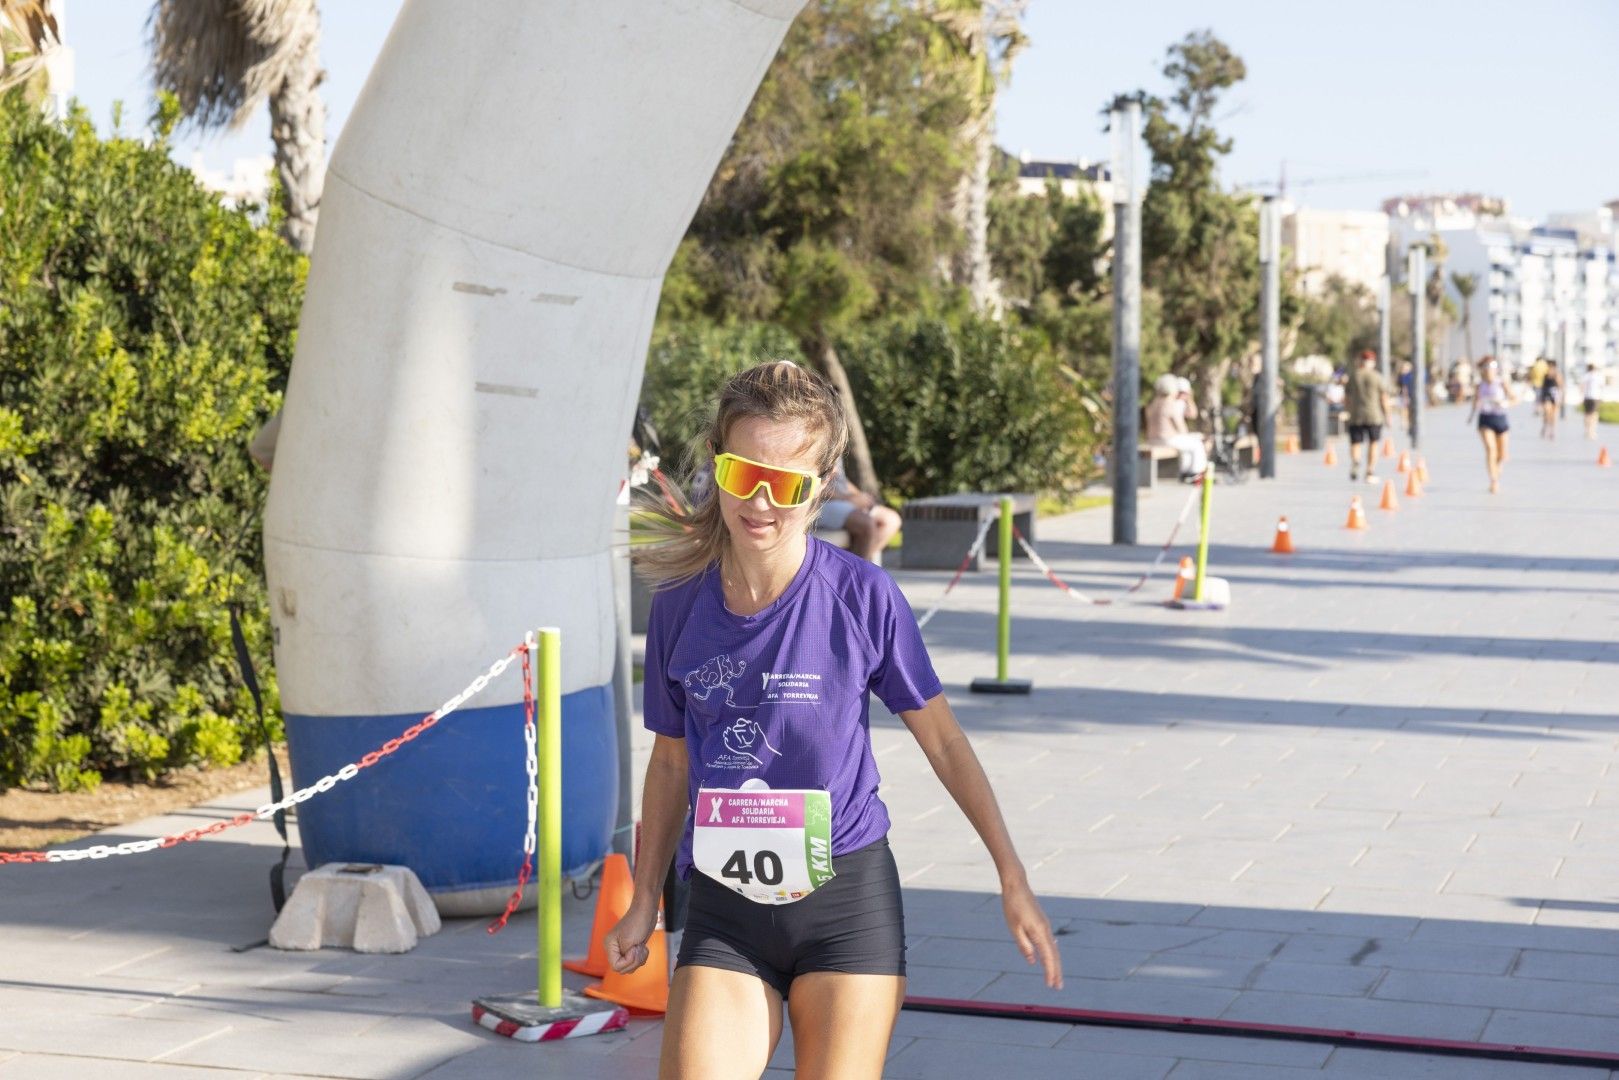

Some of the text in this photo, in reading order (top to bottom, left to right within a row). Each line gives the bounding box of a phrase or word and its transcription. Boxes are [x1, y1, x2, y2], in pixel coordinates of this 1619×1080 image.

[708, 796, 723, 823] X
[728, 798, 789, 806] CARRERA/MARCHA
[741, 807, 775, 815] SOLIDARIA
[731, 816, 786, 824] AFA TORREVIEJA
[810, 836, 829, 872] KM
[721, 850, 783, 886] 40
